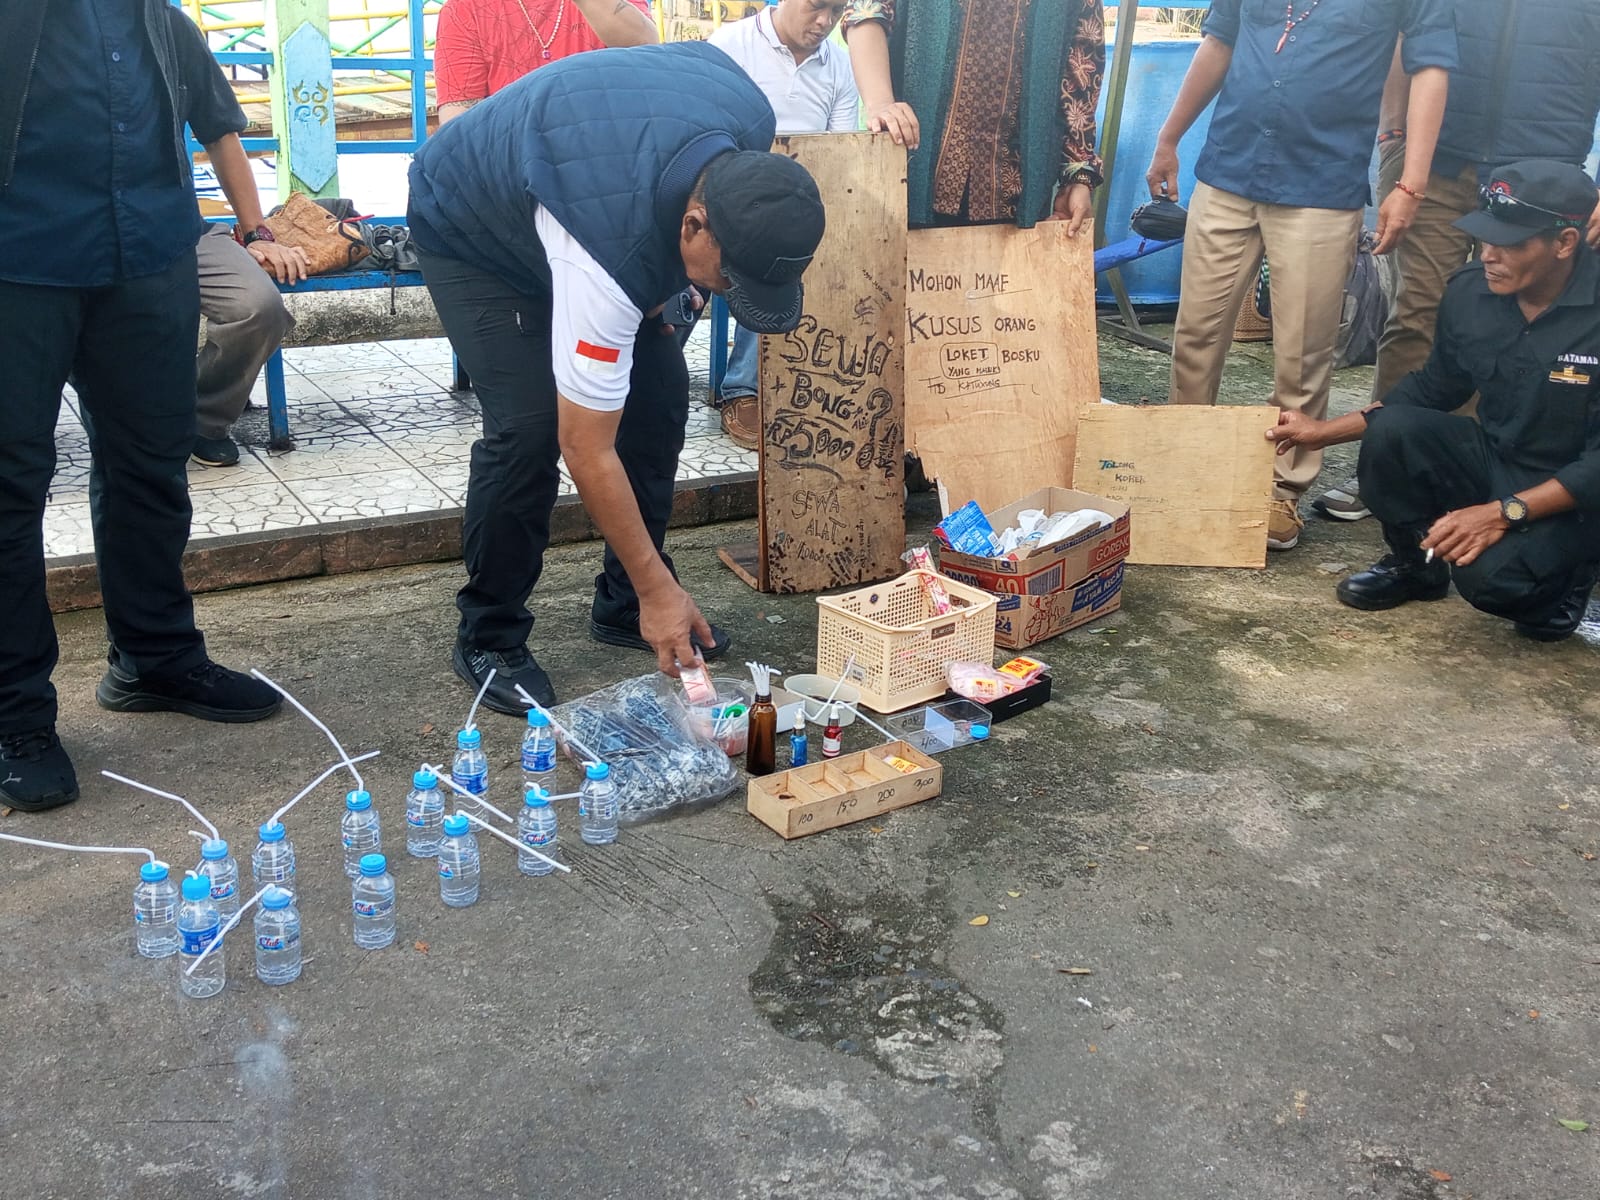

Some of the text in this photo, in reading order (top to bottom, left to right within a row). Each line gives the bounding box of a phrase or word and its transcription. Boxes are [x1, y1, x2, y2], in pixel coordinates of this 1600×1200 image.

[909, 269, 962, 292] MOHON
[975, 273, 1009, 292] MAAF
[906, 308, 1036, 344] KUSUS ORANG
[780, 315, 892, 377] SEWA
[946, 348, 1040, 363] LOKET BOSKU
[948, 366, 970, 377] YANG
[790, 373, 855, 420] BONG
[792, 487, 840, 520] SEWA
[805, 517, 847, 544] ALAT
[996, 578, 1019, 594] 40
[996, 615, 1012, 633] 24
[913, 777, 934, 791] 300
[877, 788, 896, 803] 200
[836, 798, 858, 816] 150
[798, 813, 813, 825] 100
[259, 937, 280, 948] Club
